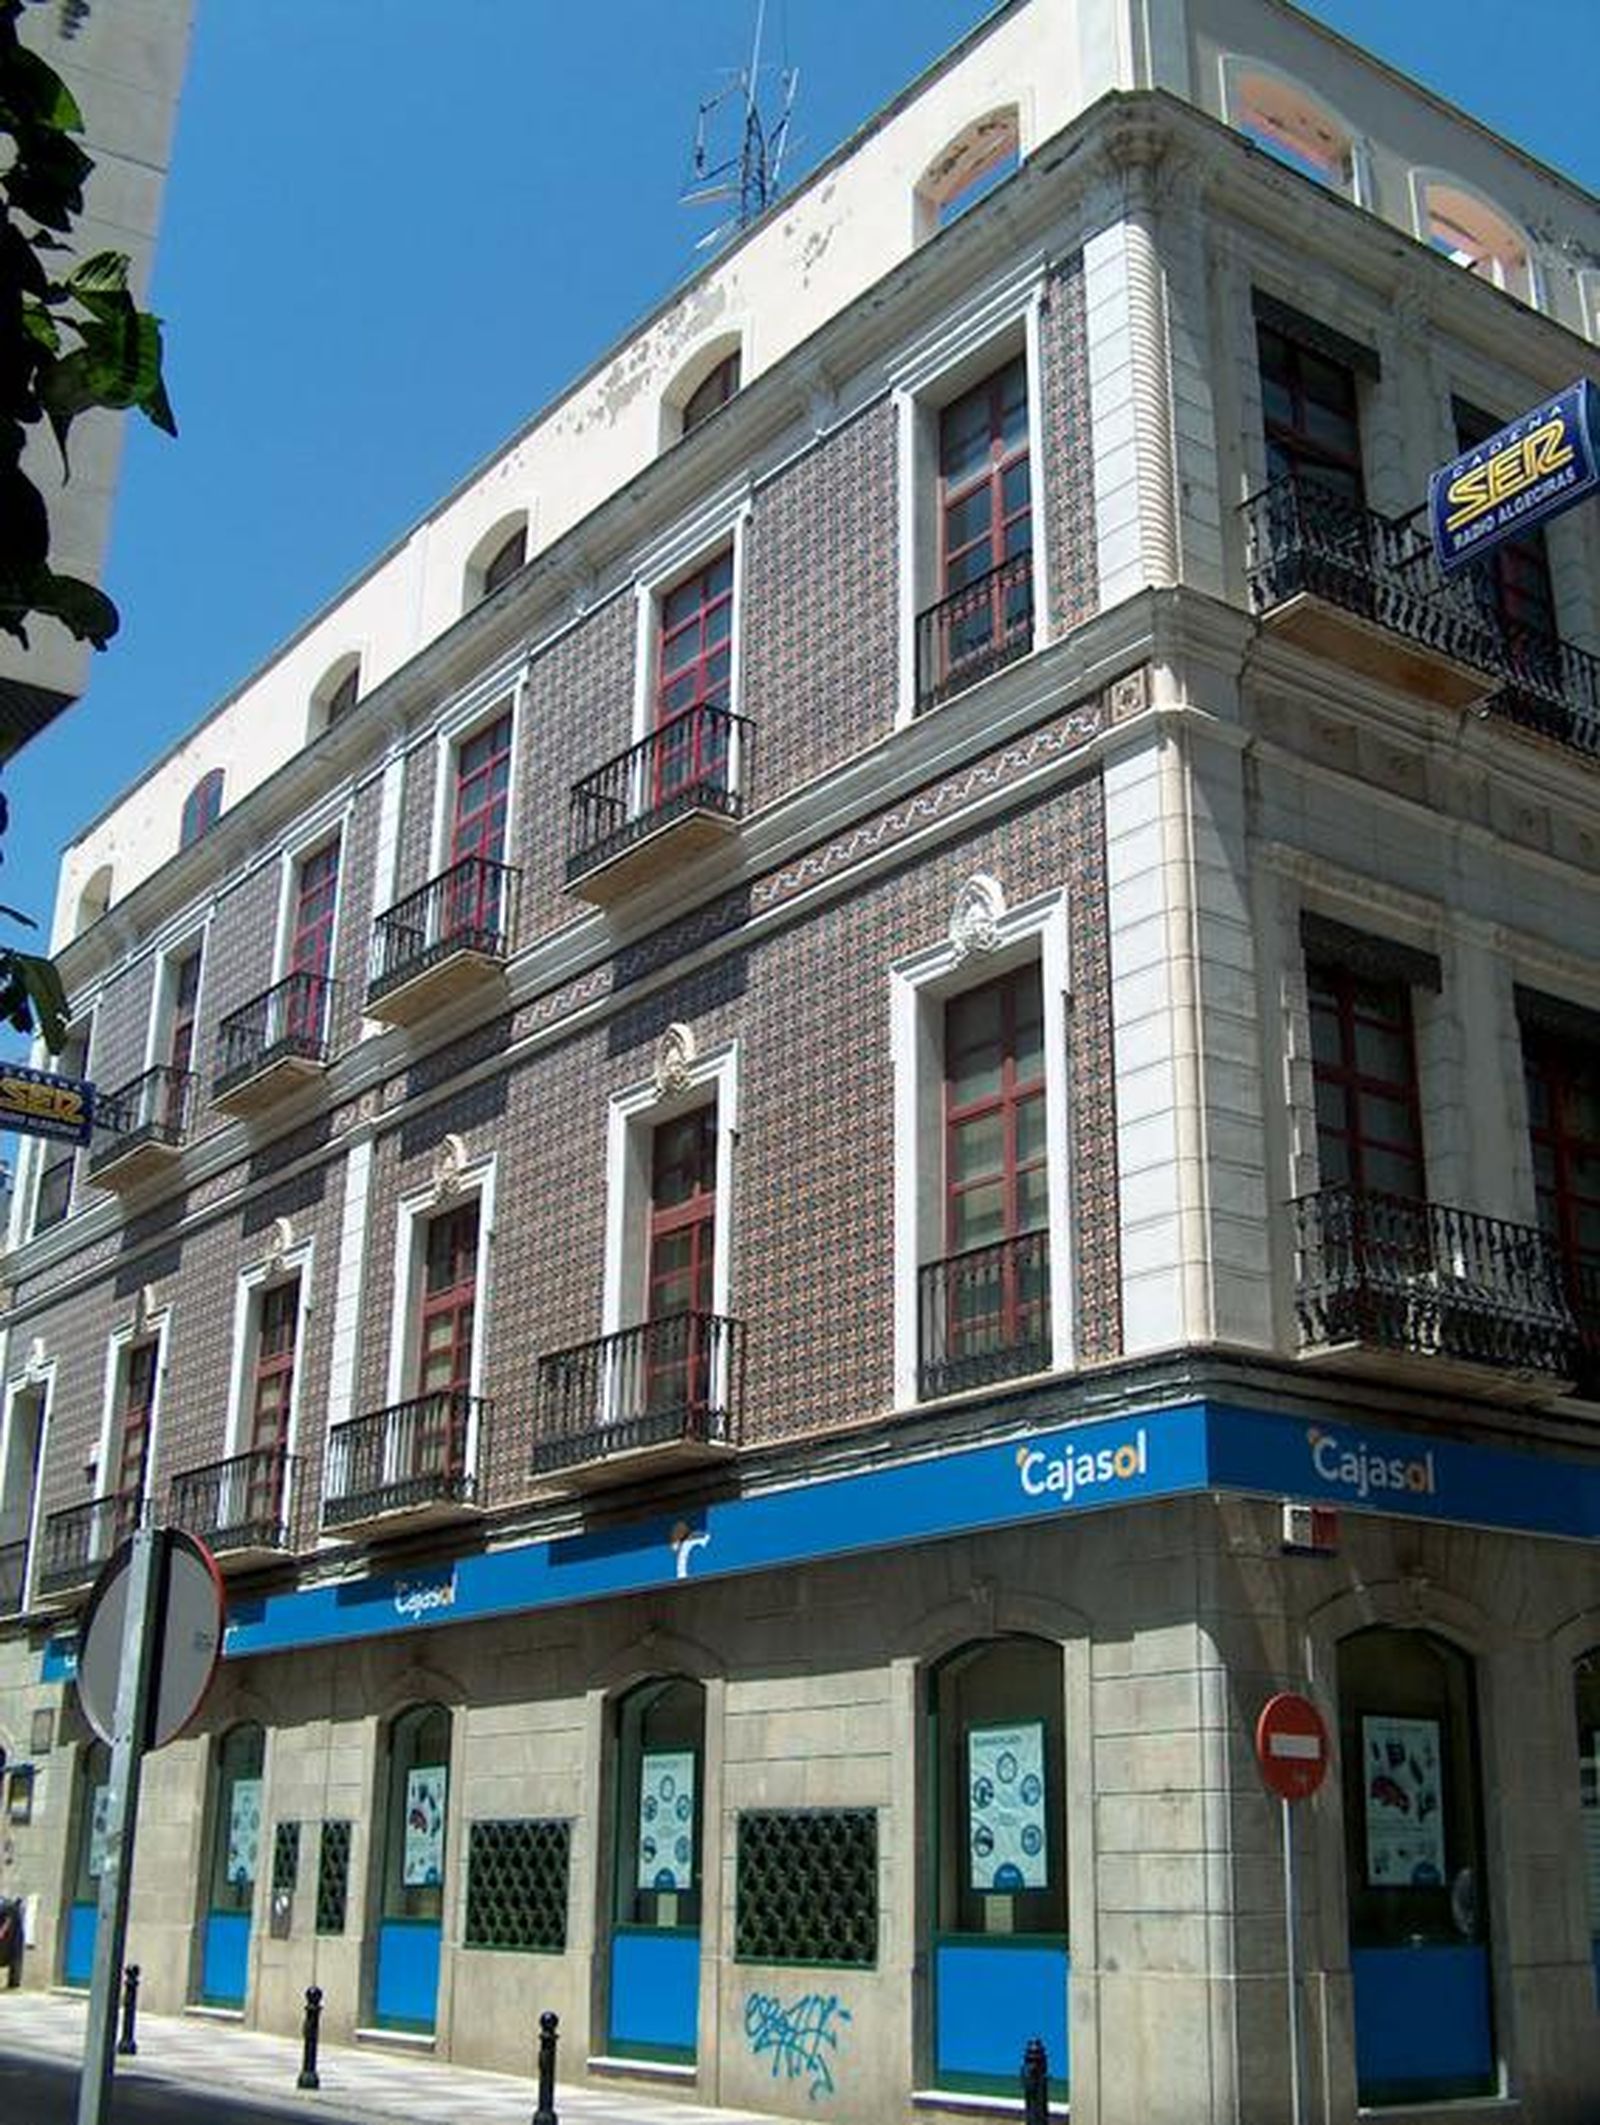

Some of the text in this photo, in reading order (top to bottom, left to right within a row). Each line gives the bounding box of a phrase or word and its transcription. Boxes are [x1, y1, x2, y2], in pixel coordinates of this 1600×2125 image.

[1446, 418, 1575, 533] SER
[1452, 405, 1562, 478] CADENA
[1452, 465, 1577, 551] RADIO ALGECIRAS
[1018, 1428, 1148, 1502] Cajasol
[1310, 1434, 1436, 1498] Cajasol
